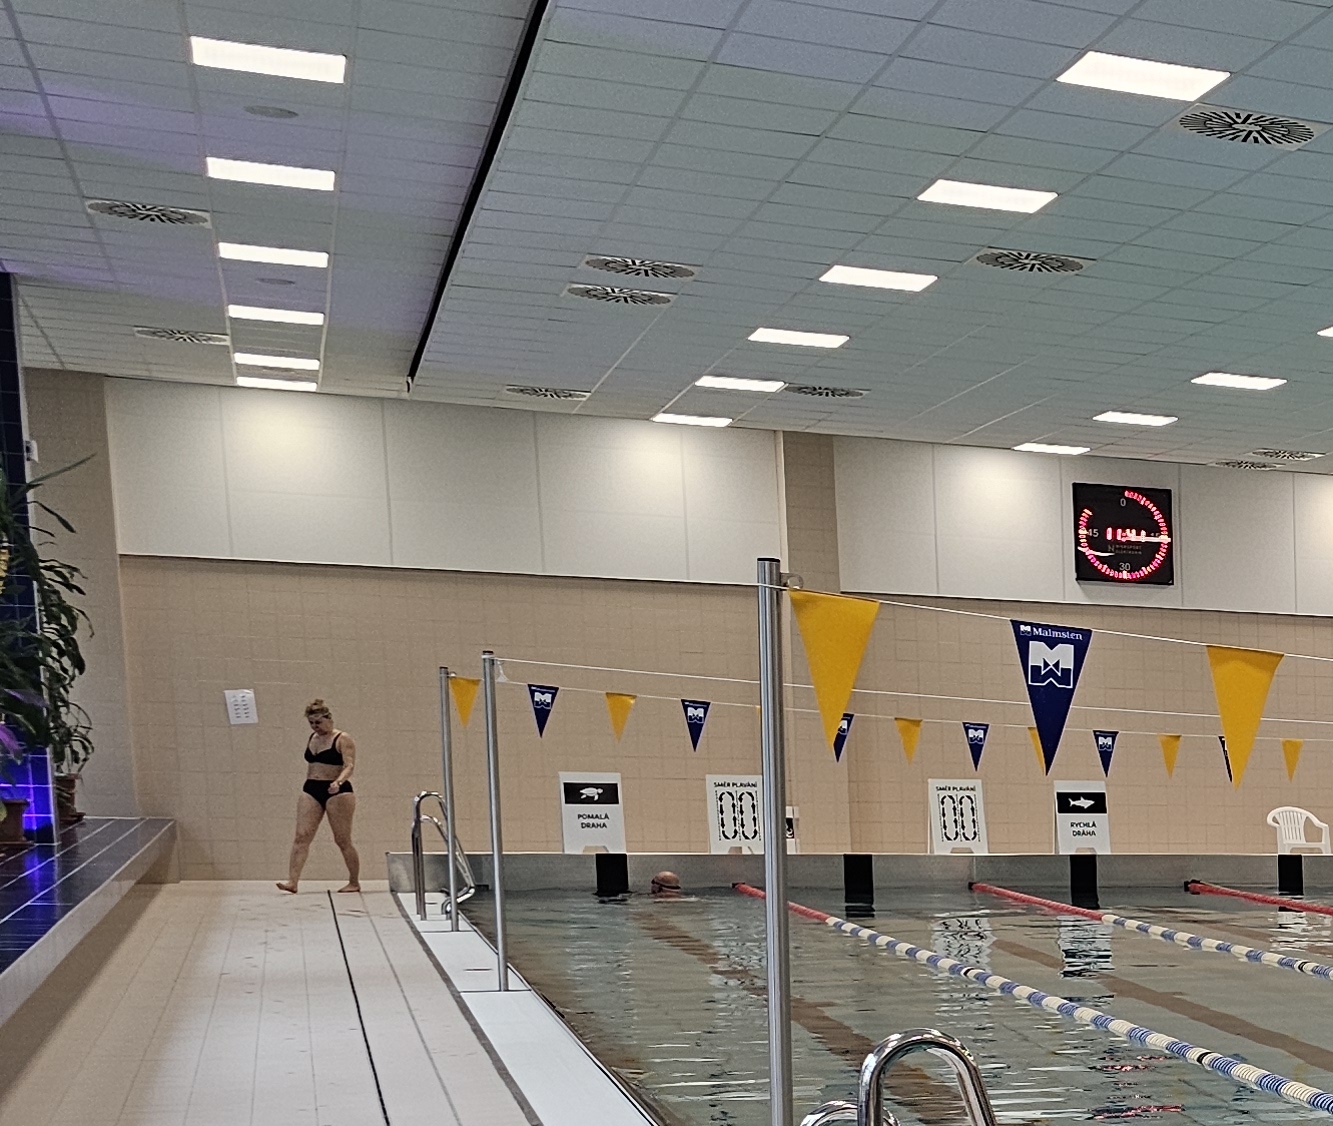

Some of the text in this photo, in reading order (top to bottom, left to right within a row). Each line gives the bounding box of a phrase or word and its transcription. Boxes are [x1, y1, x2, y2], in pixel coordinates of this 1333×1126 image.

[1087, 528, 1099, 538] 45
[1119, 562, 1131, 571] 30
[1033, 626, 1083, 640] Malmsten
[577, 812, 610, 820] POMALÁ
[1070, 820, 1097, 828] RYCHLÁ
